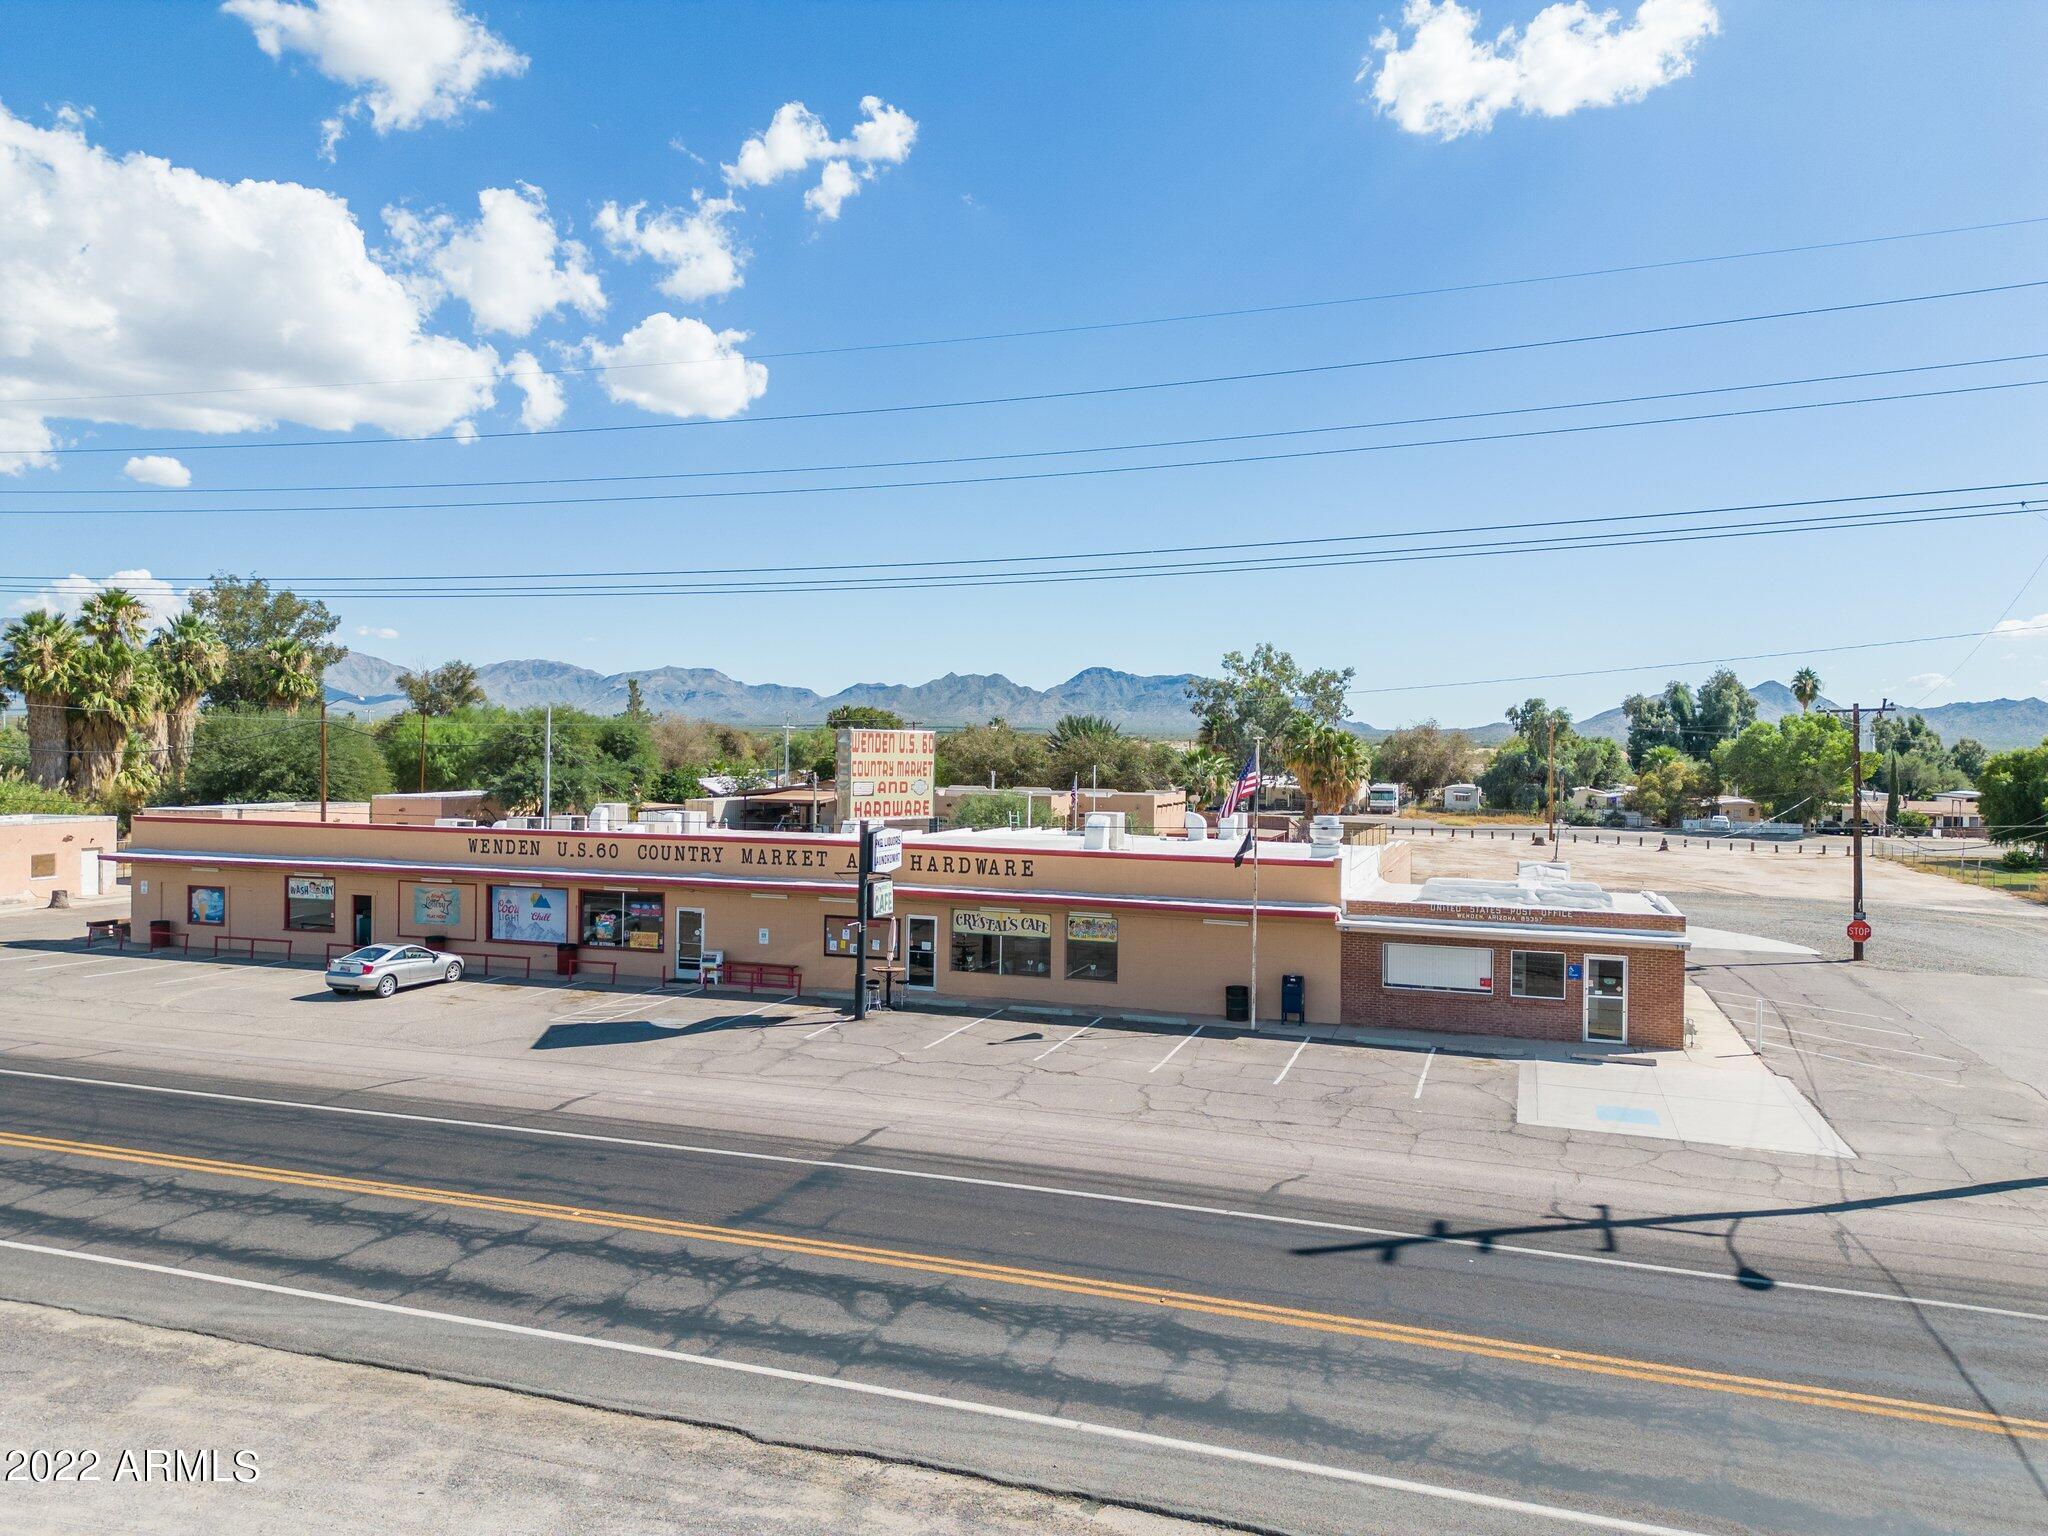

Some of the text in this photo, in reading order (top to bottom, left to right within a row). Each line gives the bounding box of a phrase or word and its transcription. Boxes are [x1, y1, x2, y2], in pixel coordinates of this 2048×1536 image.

[852, 732, 934, 754] WENDEN U.S. 60
[852, 760, 934, 777] COUNTRY MARKET
[877, 781, 908, 793] AND
[854, 800, 930, 817] HARDWARE
[884, 836, 901, 847] LIQUORS
[468, 838, 541, 856] WENDEN
[557, 841, 619, 859] U.S.60
[637, 844, 724, 863] COUNTRY
[741, 848, 828, 868] MARKET
[910, 854, 1034, 877] HARDWARE
[290, 884, 334, 895] WASH DRY
[875, 892, 892, 914] CAFE
[1430, 904, 1573, 918] UNITED STATES POST OFFICE
[955, 913, 1049, 935] CRYSTAL'S CAFE
[1848, 927, 1870, 936] STOP
